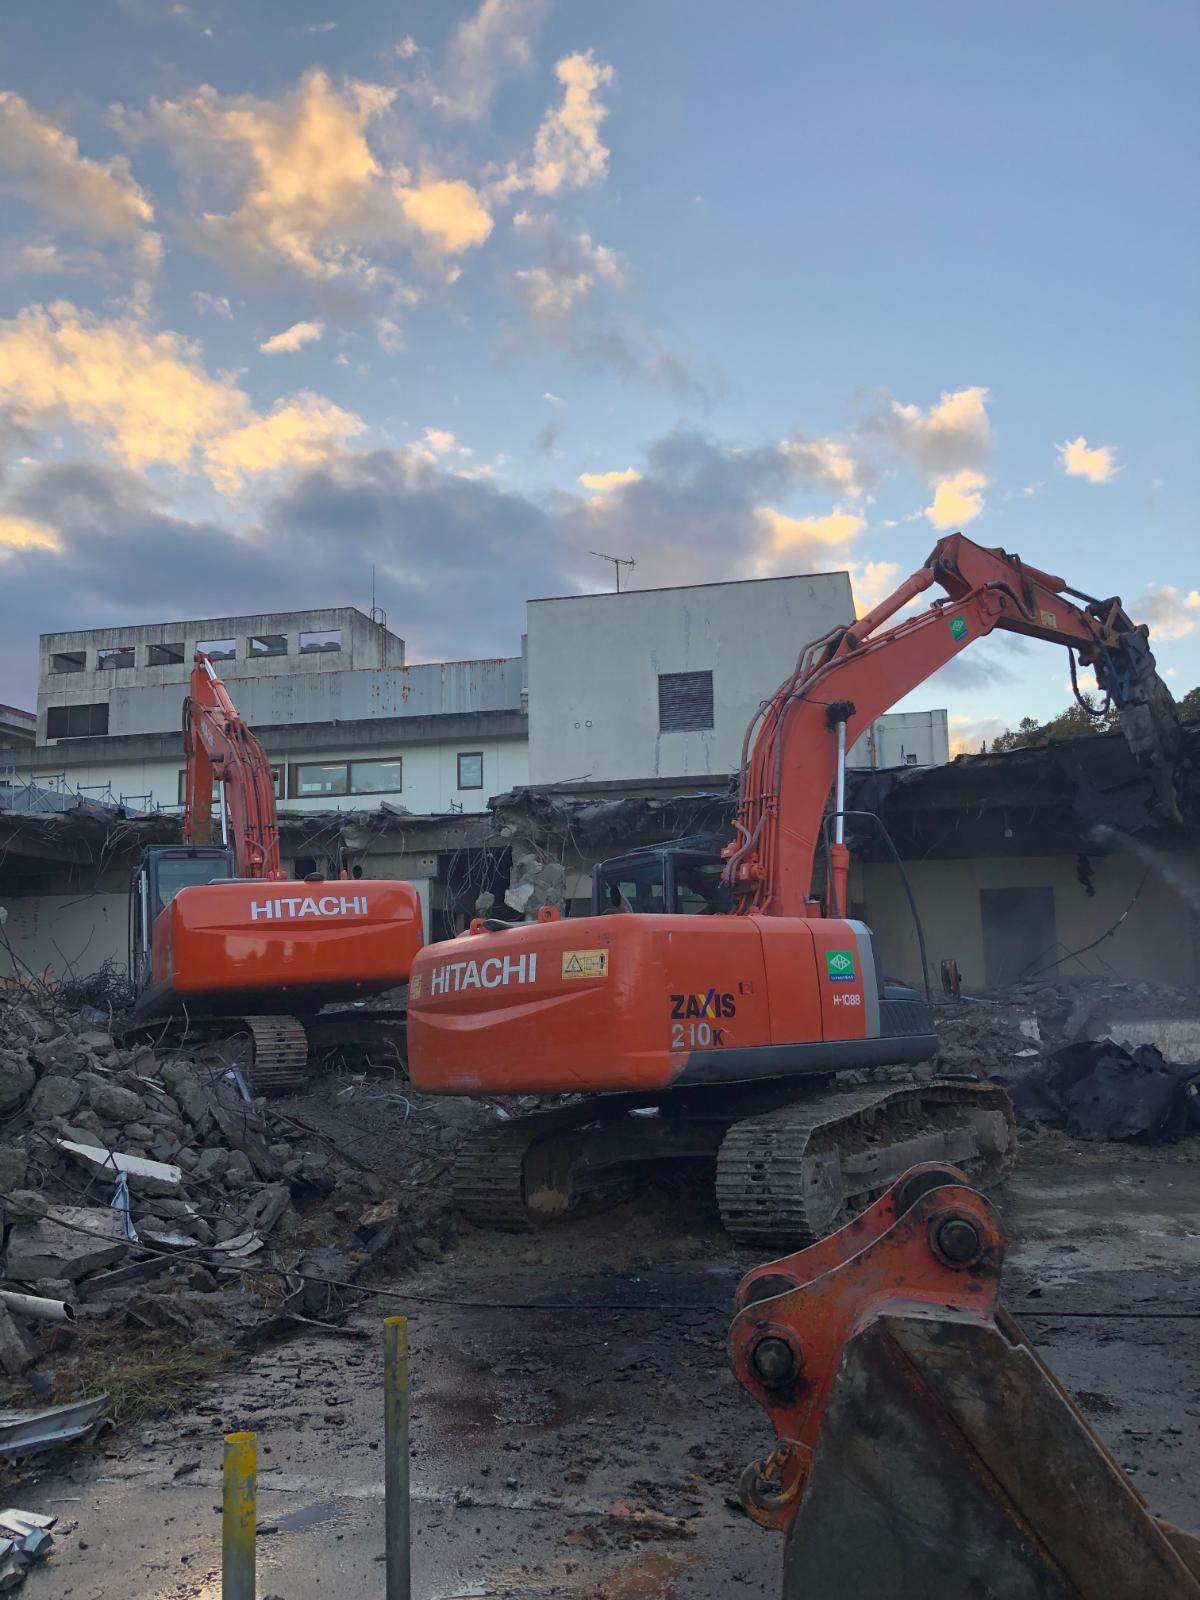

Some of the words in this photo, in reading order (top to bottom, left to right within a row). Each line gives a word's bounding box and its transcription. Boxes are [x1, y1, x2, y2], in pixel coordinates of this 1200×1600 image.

[250, 896, 368, 920] HITACHI
[430, 952, 537, 996] HITACHI
[670, 988, 736, 1019] ZAXIS
